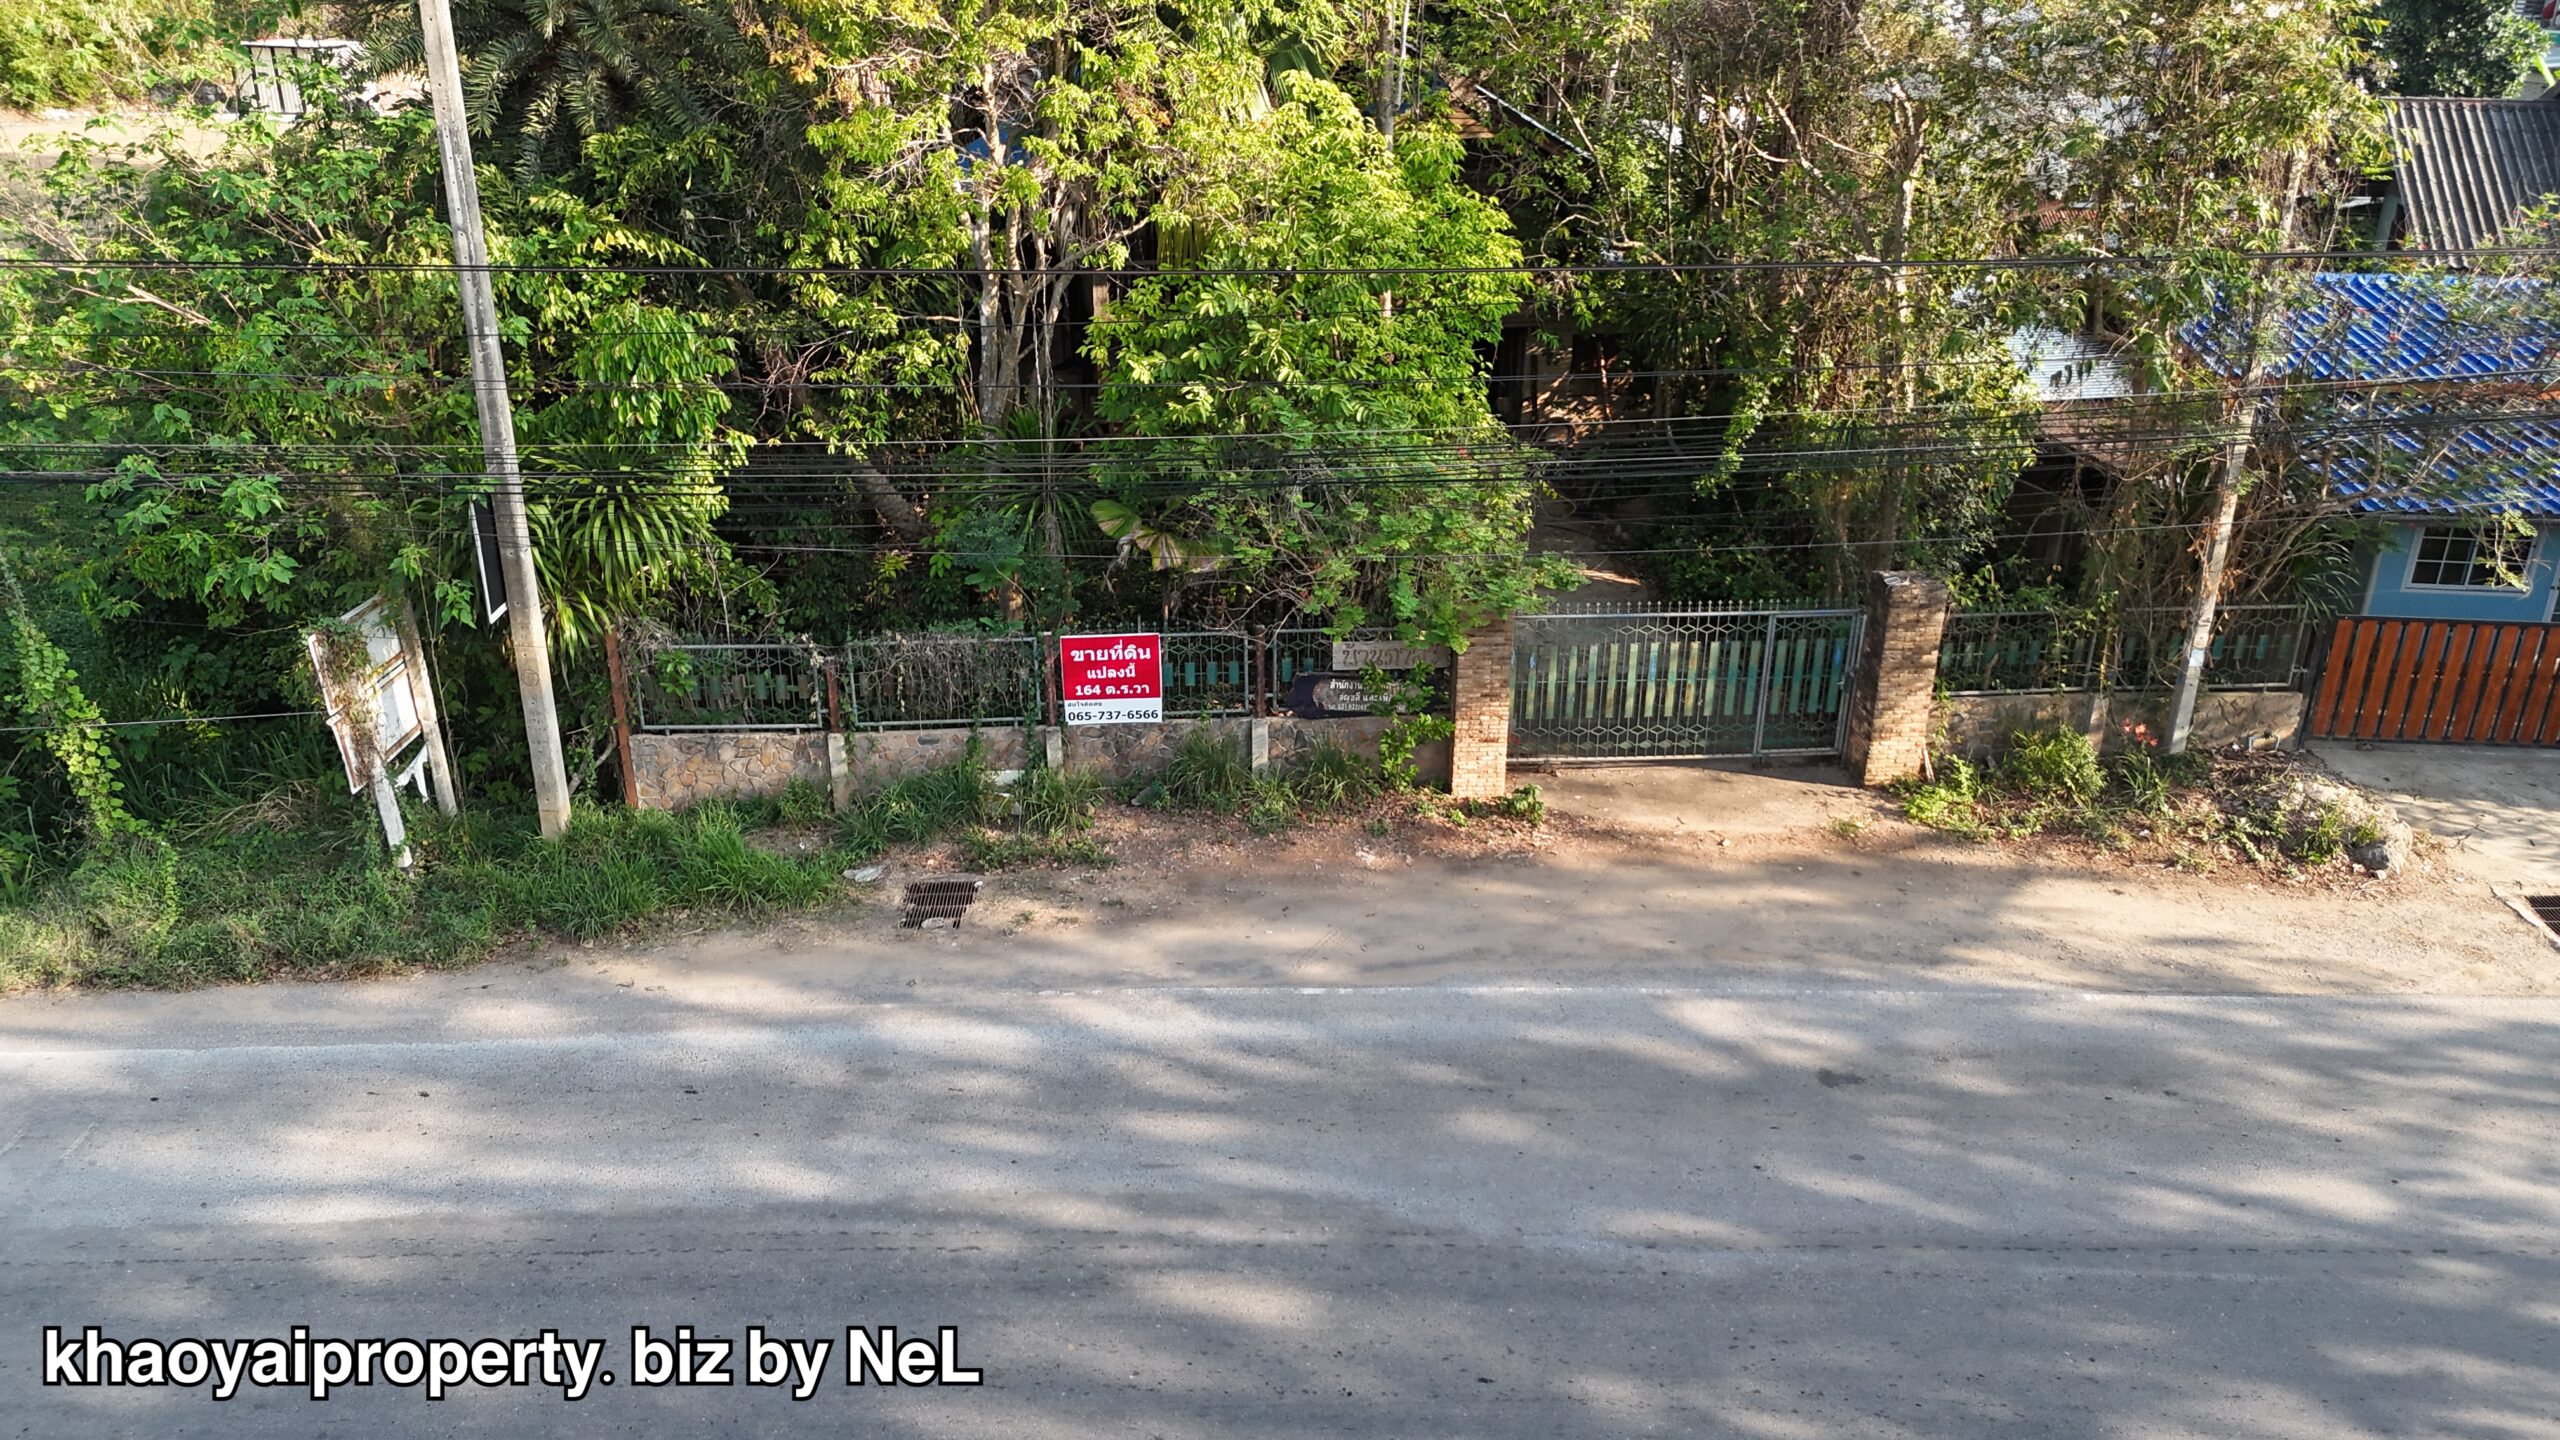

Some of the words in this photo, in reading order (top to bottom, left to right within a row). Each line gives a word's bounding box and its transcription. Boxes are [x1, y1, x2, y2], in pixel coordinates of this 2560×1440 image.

[1070, 639, 1151, 662] ขายที่ดิน
[1087, 662, 1136, 679] แปลงนี้
[1075, 684, 1101, 696] 164
[1068, 709, 1159, 721] 065-737-6566
